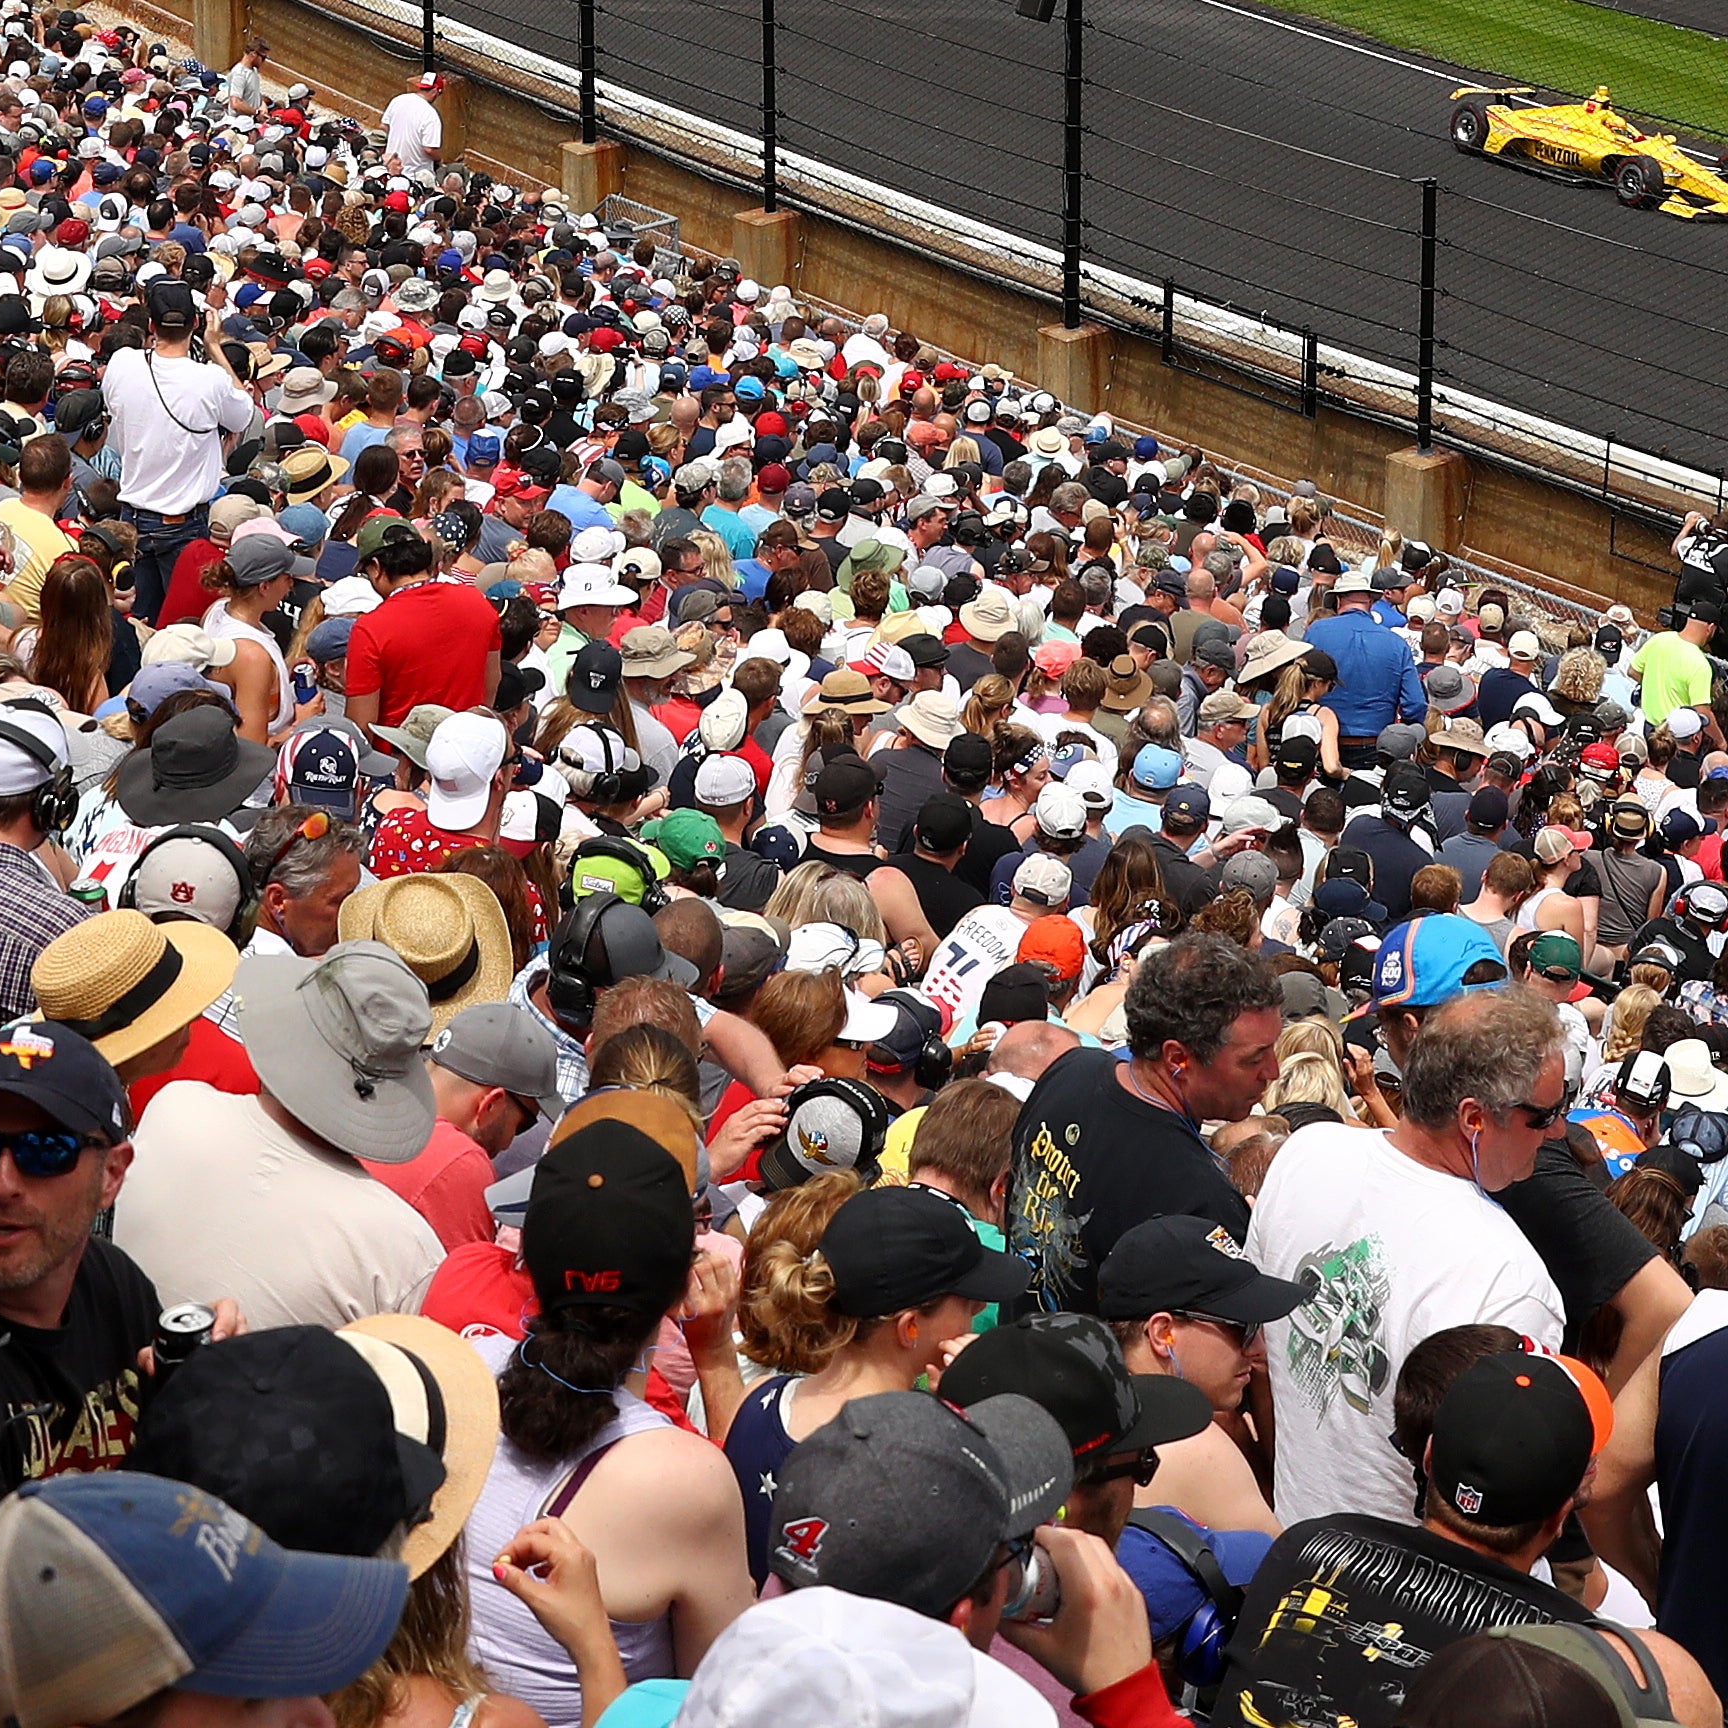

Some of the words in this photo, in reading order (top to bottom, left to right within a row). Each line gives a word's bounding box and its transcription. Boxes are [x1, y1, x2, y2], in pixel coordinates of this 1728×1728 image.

[956, 919, 1010, 965] FREEDOM
[1031, 1121, 1081, 1198] Protect
[781, 1517, 828, 1560] 4
